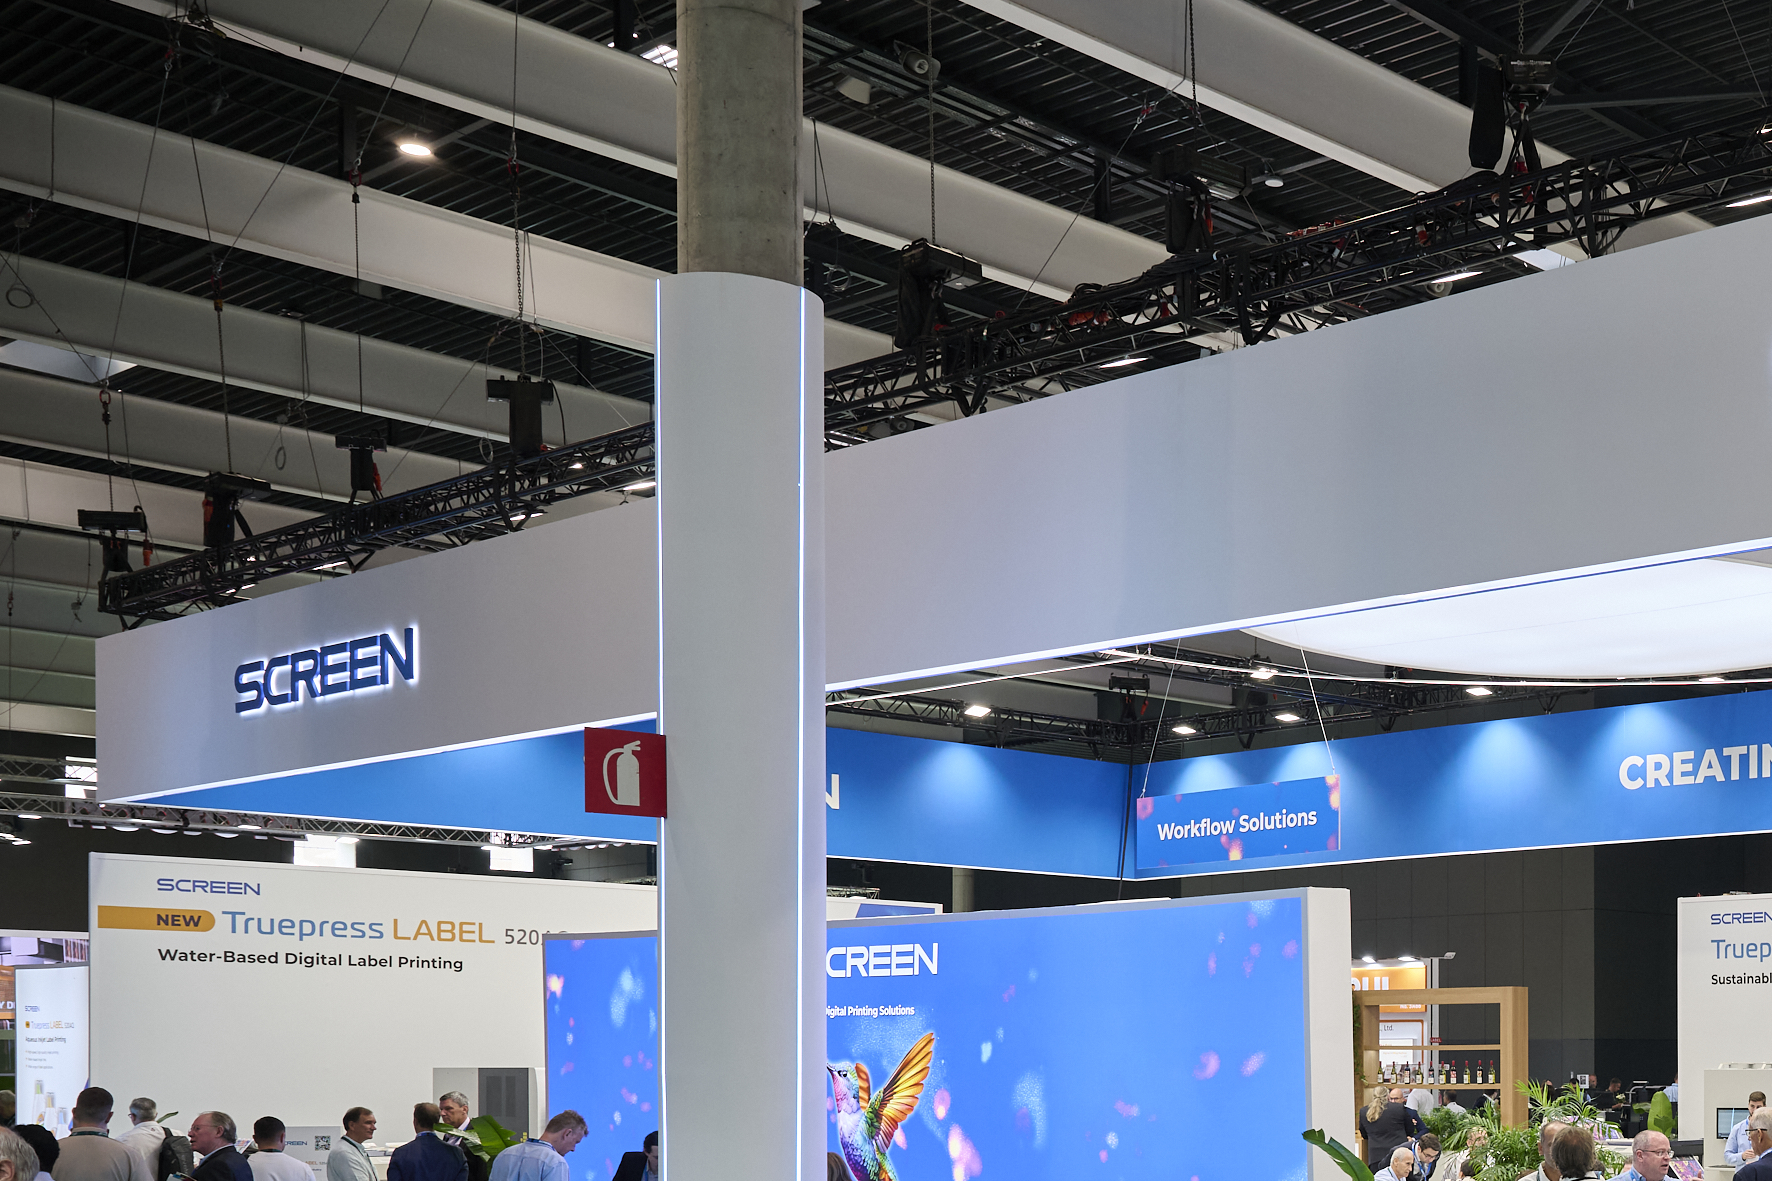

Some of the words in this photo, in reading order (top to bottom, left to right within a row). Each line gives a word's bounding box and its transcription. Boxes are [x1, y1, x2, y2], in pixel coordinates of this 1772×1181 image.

[234, 627, 415, 713] SCREEN
[1157, 813, 1236, 842] Workflow
[1239, 808, 1318, 836] Solutions
[156, 878, 261, 896] SCREEN
[156, 913, 202, 928] NEW
[221, 910, 384, 942] Truepress
[393, 918, 496, 944] LABEL
[505, 928, 568, 946] 520
[157, 948, 279, 965] Water-Based
[285, 951, 342, 969] Digital
[348, 954, 393, 968] Label
[398, 956, 464, 973] Printing
[847, 1005, 878, 1018] Printing
[879, 1004, 915, 1016] Solutions
